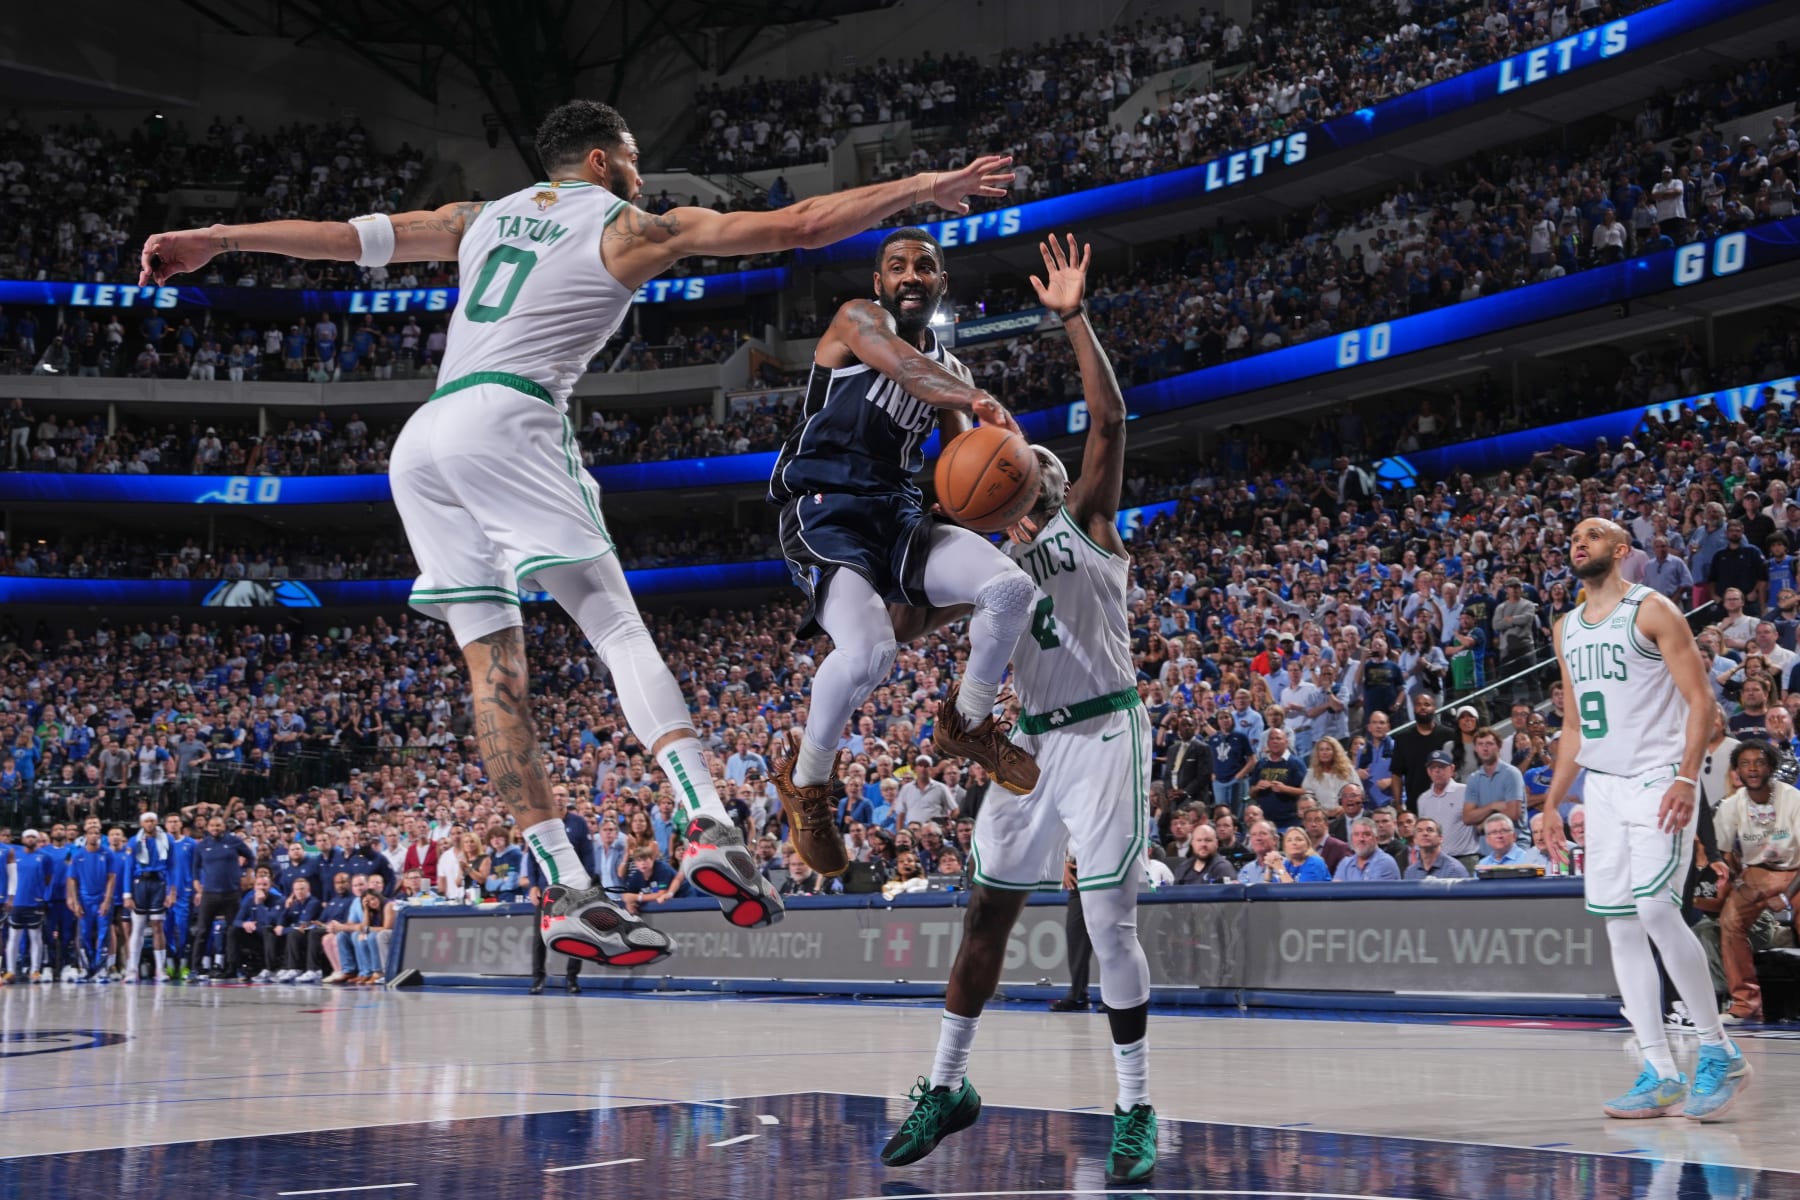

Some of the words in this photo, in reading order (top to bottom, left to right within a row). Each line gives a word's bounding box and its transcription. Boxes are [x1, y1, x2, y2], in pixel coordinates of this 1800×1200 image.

[1498, 20, 1628, 94] LET'S
[1205, 132, 1308, 192] LET'S
[496, 215, 569, 246] TATUM
[922, 207, 1022, 247] ET'S
[1673, 231, 1747, 286] GO
[70, 284, 179, 308] LET'S
[349, 290, 448, 313] LET'S
[464, 244, 538, 323] 0
[631, 278, 705, 303] ET'S
[1336, 321, 1391, 369] GO
[1067, 400, 1089, 434] G
[225, 475, 282, 504] GO
[1017, 531, 1077, 588] TICS
[1566, 642, 1628, 685] ELTICS
[1580, 691, 1609, 739] 9
[455, 927, 534, 965] TISSO
[674, 931, 744, 959] FFICIAL
[748, 932, 823, 960] WATCH
[919, 920, 1070, 971] TISO
[1279, 928, 1439, 964] OFFICIAL
[1447, 928, 1593, 966] WATCH
